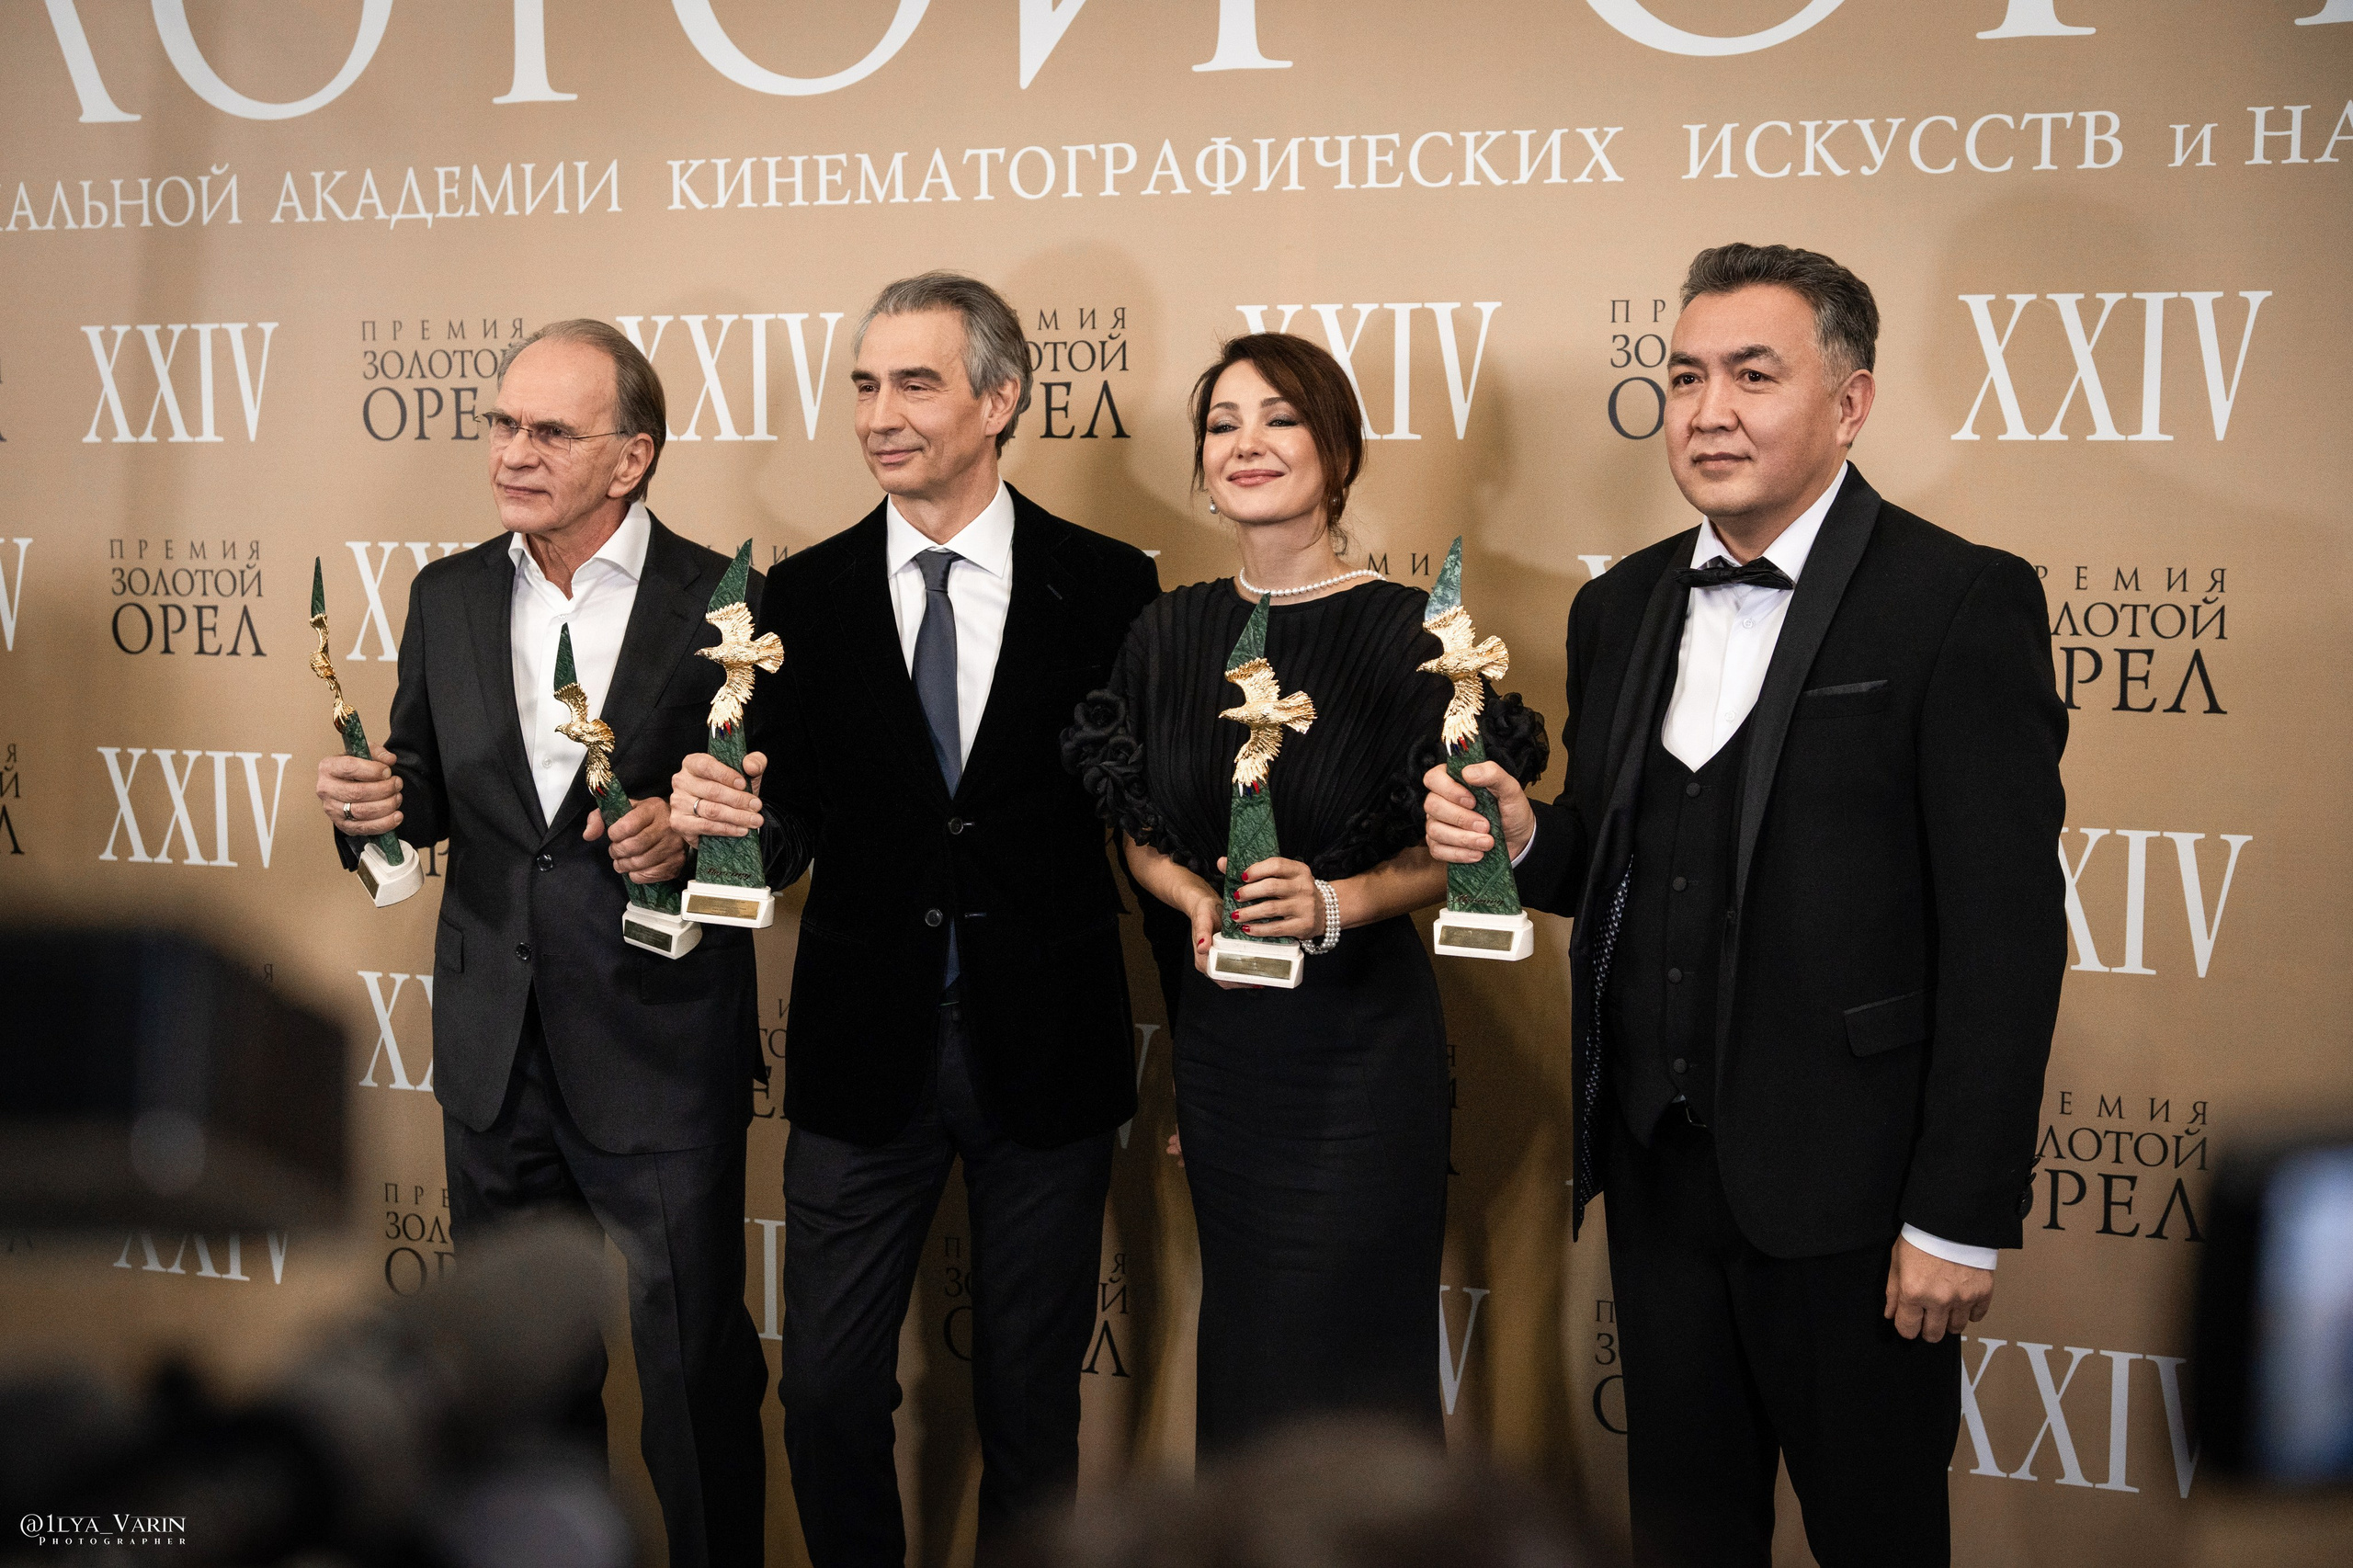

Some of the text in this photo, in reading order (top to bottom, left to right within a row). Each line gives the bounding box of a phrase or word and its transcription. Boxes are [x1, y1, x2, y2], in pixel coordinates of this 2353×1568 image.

[0, 163, 243, 233] АЛЬНОЙ
[270, 158, 623, 231] АКАДЕМИИ
[666, 127, 1625, 211] КИНЕМАТОГРАФИЧЕСКИХ
[1681, 110, 2124, 180] ИСКУССТВ
[2244, 99, 2353, 165] НА
[360, 317, 525, 342] ПРЕМИЯ
[1037, 306, 1128, 331] МИЯ
[80, 321, 279, 443] XXIV
[1235, 301, 1503, 440] XIV
[1949, 290, 2273, 442] XXIV
[362, 386, 492, 441] ОРЕ
[1039, 379, 1131, 439] ЕЛ
[108, 539, 261, 561] ПРЕМИЯ
[110, 563, 264, 598] ЗОЛОТОЙ
[111, 602, 267, 657] ОРЕЛ
[2051, 596, 2229, 641] ЛОТОЙ
[2059, 645, 2228, 715] РЕЛ
[97, 746, 292, 869] XXIV
[2058, 826, 2254, 979] XIV
[2059, 1091, 2210, 1126] ЕМИЯ
[2037, 1125, 2210, 1172] ЛОТОЙ
[2021, 1168, 2209, 1243] РЕЛ
